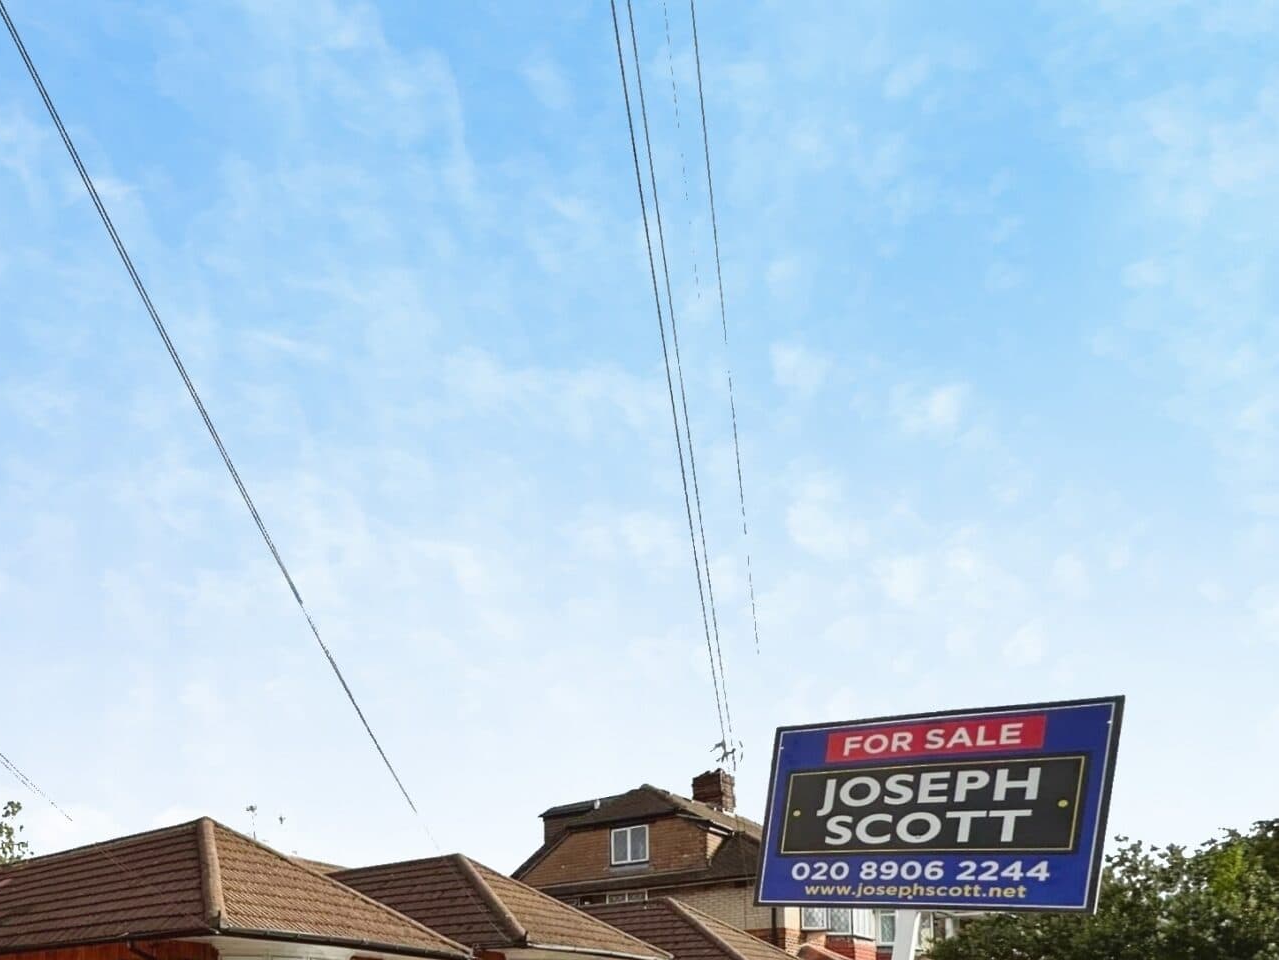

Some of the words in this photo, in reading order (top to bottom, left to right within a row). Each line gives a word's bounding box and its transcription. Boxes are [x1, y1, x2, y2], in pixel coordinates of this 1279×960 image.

[843, 733, 913, 756] FOR
[923, 722, 1024, 750] SALE
[817, 767, 1042, 816] JOSEPH
[824, 809, 1033, 845] SCOTT
[791, 861, 850, 881] 020
[859, 860, 944, 881] 8906
[956, 860, 1051, 881] 2244
[805, 882, 1027, 898] www.josephscott.net
